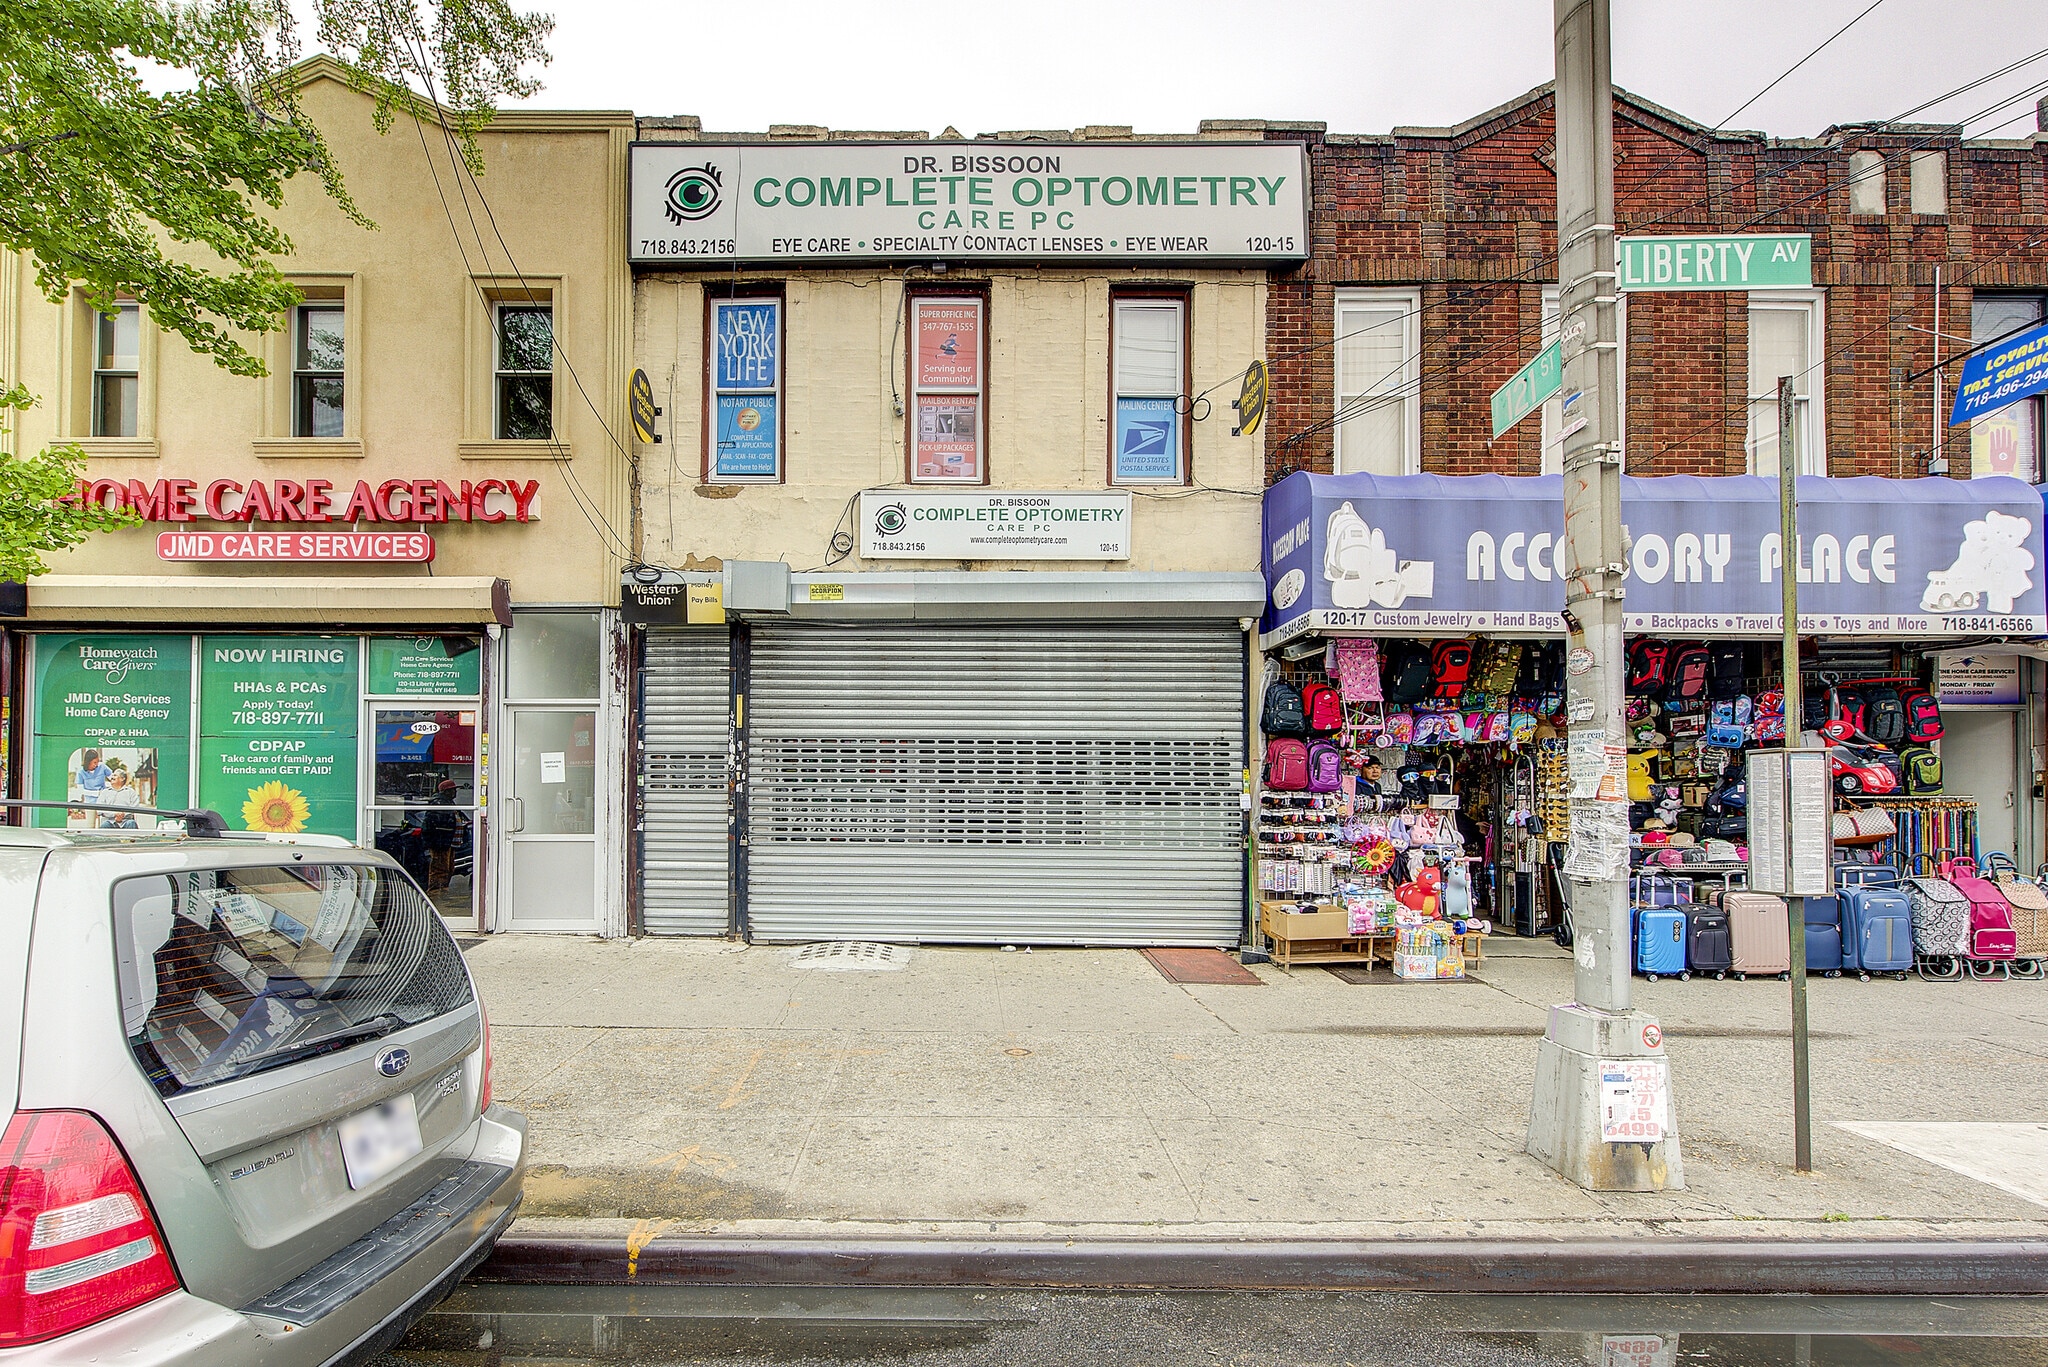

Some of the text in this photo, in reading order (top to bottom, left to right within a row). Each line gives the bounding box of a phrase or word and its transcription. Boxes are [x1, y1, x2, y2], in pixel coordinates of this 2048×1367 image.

[904, 156, 1061, 174] DR. BISSOON
[753, 176, 1287, 207] COMPLETE OPTOMETRY
[918, 210, 1015, 230] CARE
[641, 238, 735, 255] 718.843.2156
[772, 235, 1209, 253] EYE CARE SPECIALTY CONTACT LENSES EYE WEAR
[1246, 237, 1294, 252] 120-15
[1625, 241, 1802, 283] LIBERTY AV
[919, 310, 977, 318] SUPER OFFICE INC.
[727, 310, 770, 335] NEW
[923, 323, 974, 331] 347-767-1555
[719, 333, 774, 358] YORK
[726, 356, 768, 382] LIFE
[924, 364, 956, 374] Serving
[922, 374, 974, 385] Community!
[1505, 348, 1556, 422] 121 ST
[1963, 374, 1993, 397] TAX
[1241, 377, 1263, 409] Western
[721, 398, 773, 408] NOTARY PUBLIC
[1118, 401, 1174, 410] MAILING CENTER
[1243, 394, 1260, 417] Union
[205, 479, 333, 524] CARE
[343, 479, 541, 524] AGENCY
[989, 499, 1050, 507] DR. BISSOON
[913, 508, 1124, 522] COMPLETE OPTOMETRY
[987, 524, 1025, 532] CARE
[1295, 516, 1310, 549] PLACE
[163, 535, 425, 558] JMD CARE SERVICES
[872, 542, 926, 551] 718.843.2156
[970, 535, 1068, 547] www.completeoptometrycare.com
[1099, 543, 1119, 552] 120-15
[1467, 531, 1897, 584] ACCORY PLACE
[629, 584, 678, 595] Western
[638, 594, 672, 606] Union
[691, 596, 703, 604] Pay
[1279, 614, 1310, 641] 718-841-6566
[1323, 611, 1367, 626] 120-17
[1373, 612, 1421, 626] Custom
[1423, 611, 1473, 630] Jewelry
[1493, 612, 1525, 627] Hand
[1528, 612, 1560, 630] Bags
[1651, 615, 1719, 630] Backpacks
[1735, 616, 1774, 630] Travel
[1833, 616, 1862, 632] Toys
[1868, 617, 1890, 630] and
[1897, 617, 1928, 631] More
[1942, 617, 2034, 631] 718-841-6566
[79, 646, 158, 659] Homewatch
[214, 648, 344, 663] NOW HIRING
[82, 658, 157, 685] CareGivers
[233, 682, 327, 693] HHAs & PCAs
[64, 693, 171, 704] JMD Care Services
[242, 700, 314, 710] Apply Today!
[65, 707, 170, 720] Home Care Agency
[232, 711, 324, 725] 718-897-7711
[84, 729, 118, 737] CDPAP
[98, 738, 136, 746] Services
[249, 740, 306, 752] CDPAP
[221, 754, 245, 763] Take
[271, 754, 281, 763] of
[283, 754, 314, 764] family
[315, 755, 334, 763] and
[222, 766, 332, 774] friends and GET PAID!
[229, 1148, 295, 1180] SUBARU
